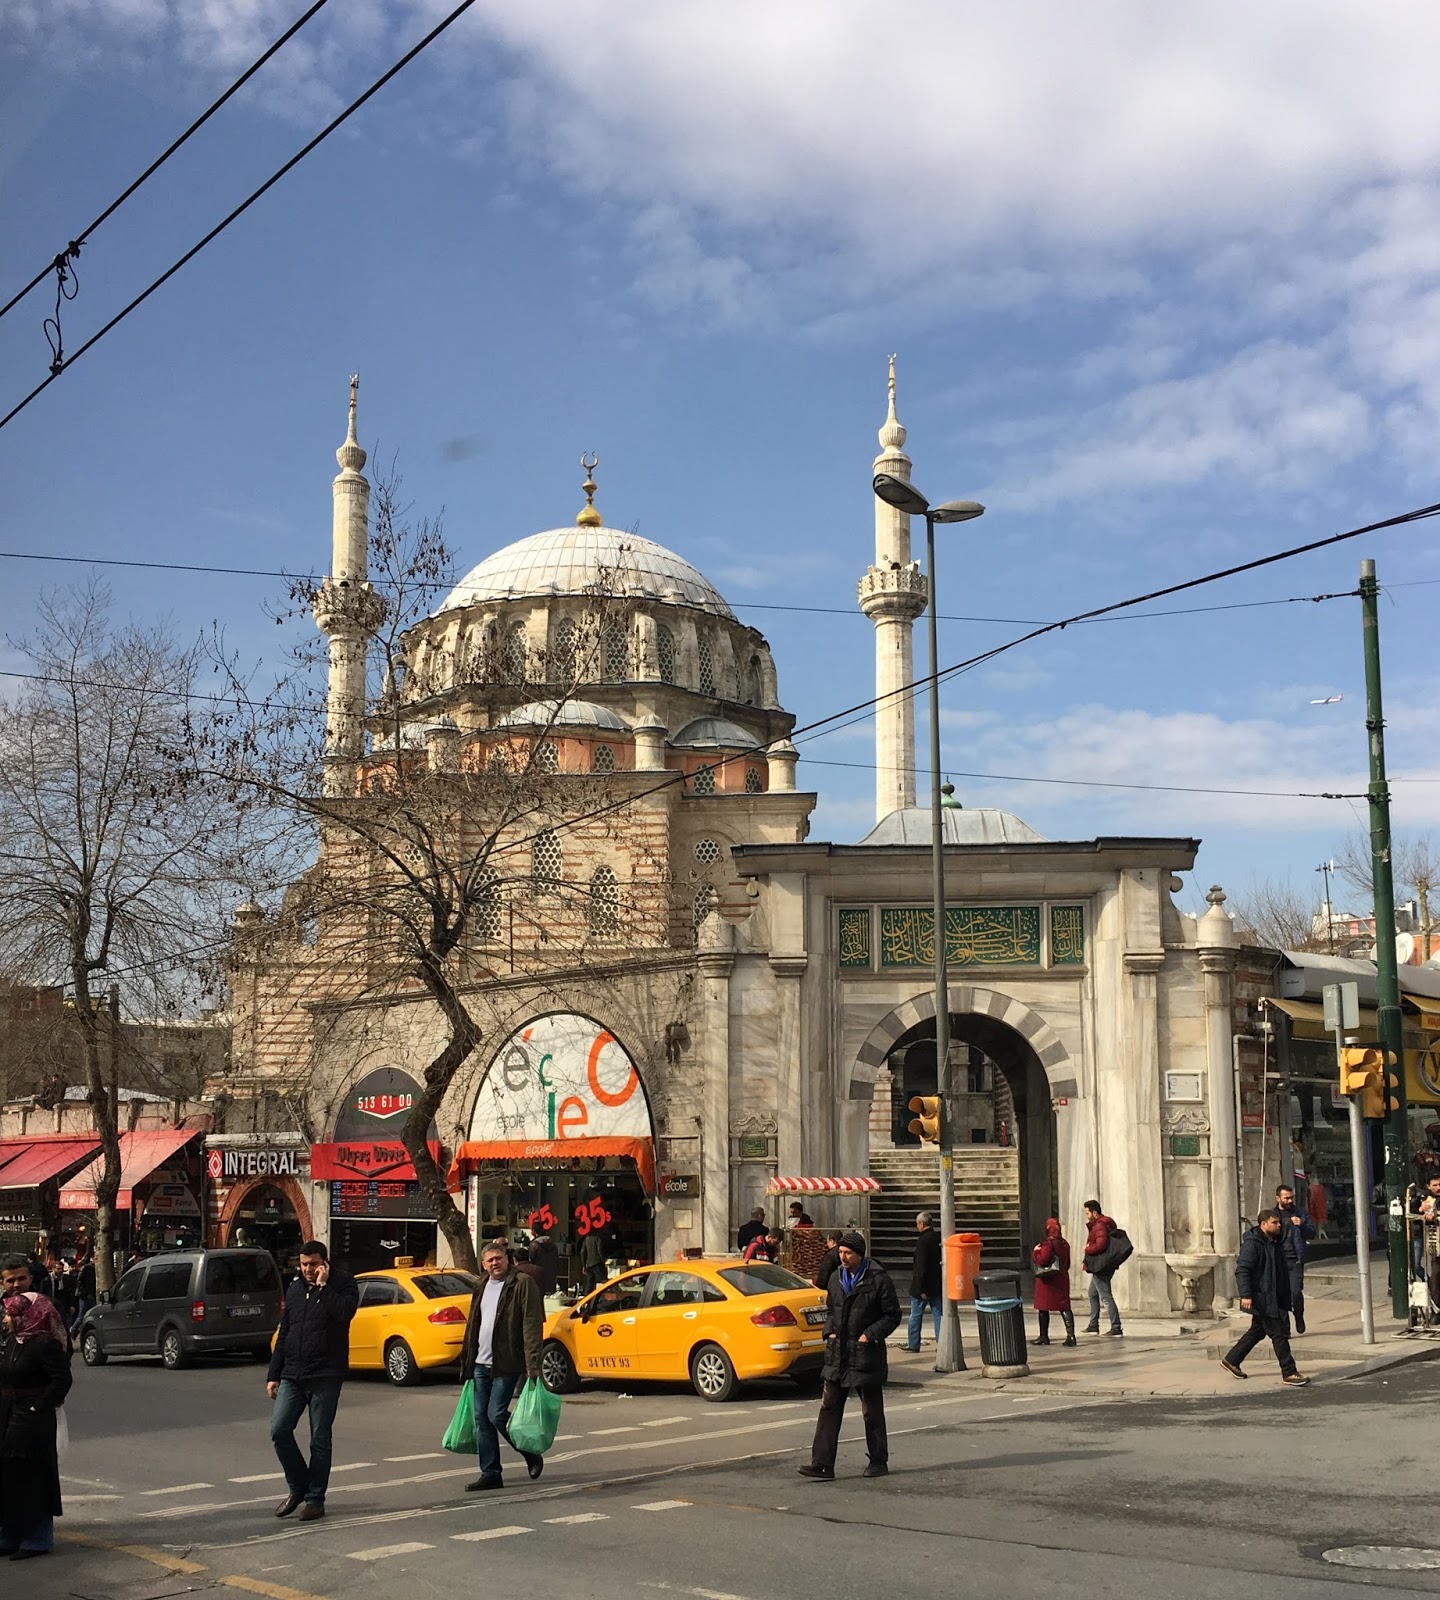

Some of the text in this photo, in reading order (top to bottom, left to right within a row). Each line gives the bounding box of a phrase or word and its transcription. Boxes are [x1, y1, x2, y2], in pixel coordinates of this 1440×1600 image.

[358, 1093, 412, 1109] 513 61 00
[224, 1151, 299, 1175] INTEGRAL
[665, 1179, 688, 1192] école
[588, 1357, 599, 1368] 34
[619, 1357, 630, 1368] 93
